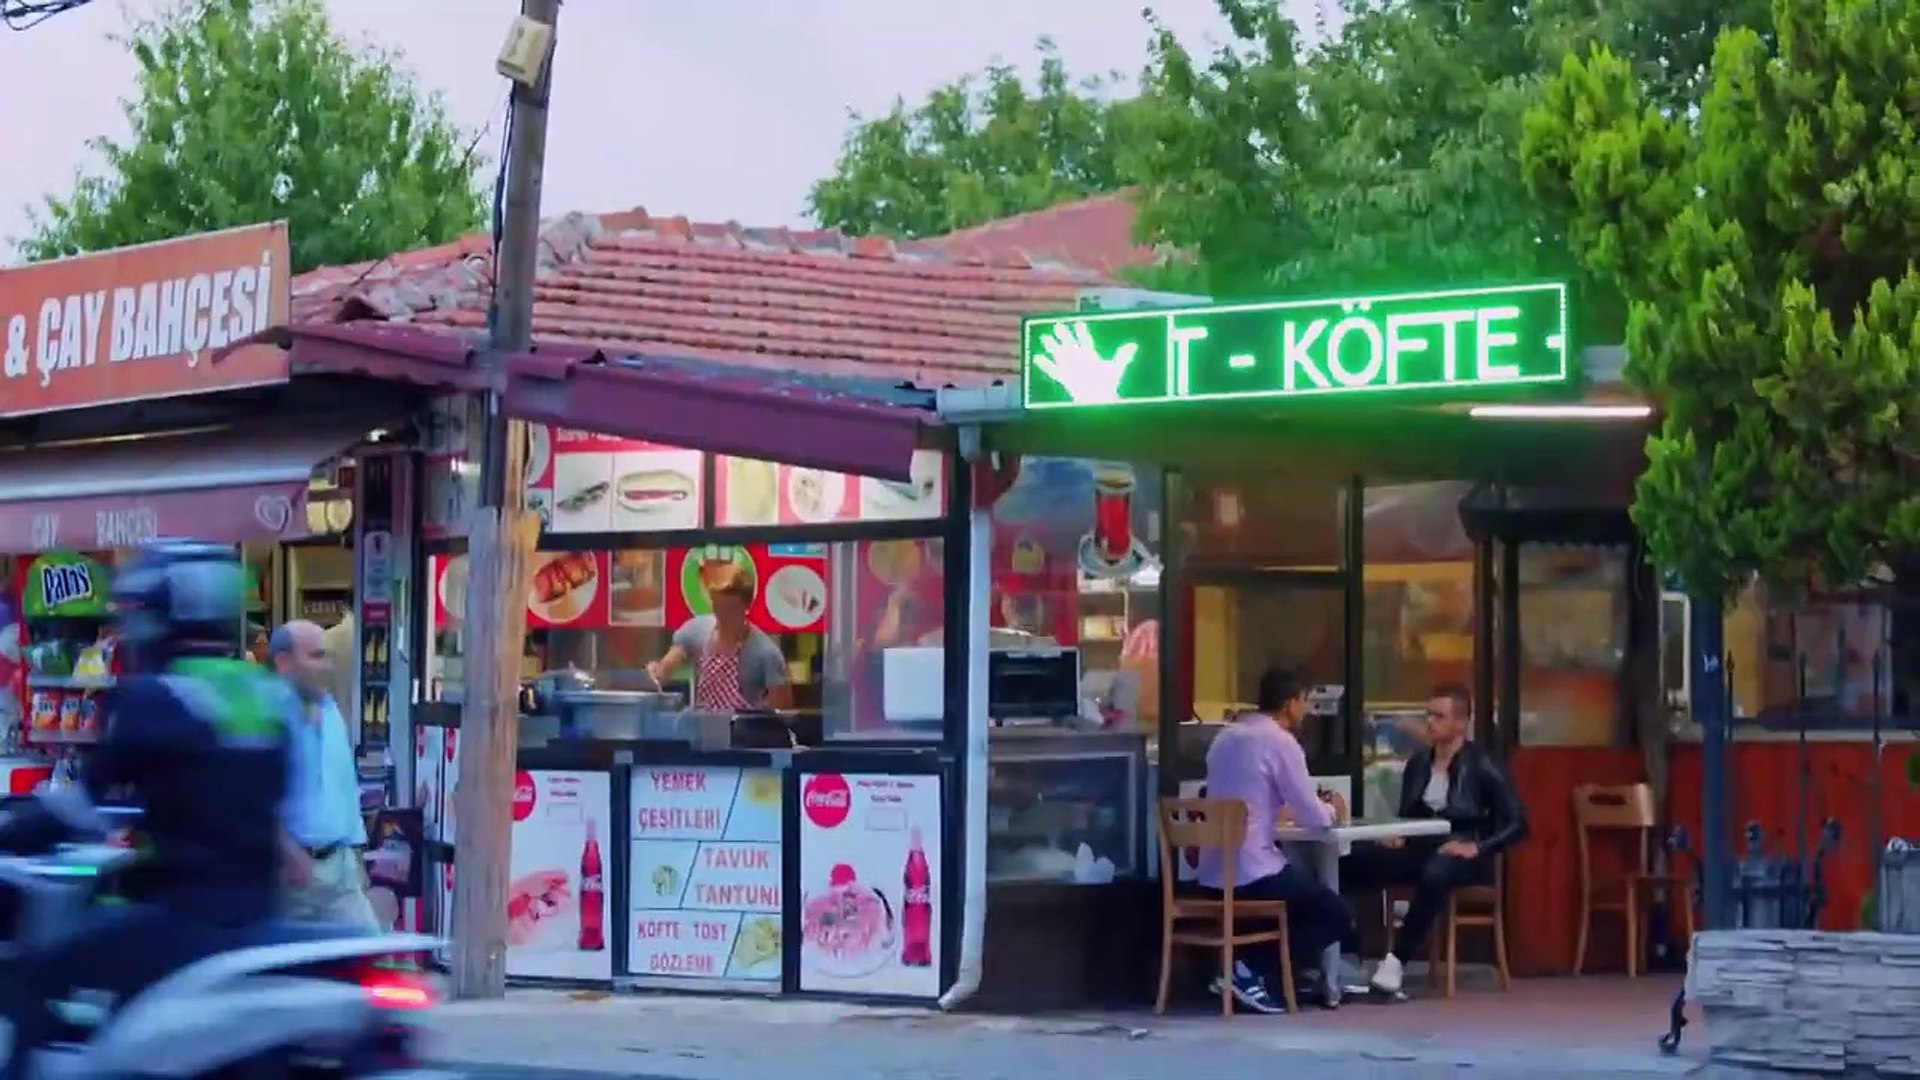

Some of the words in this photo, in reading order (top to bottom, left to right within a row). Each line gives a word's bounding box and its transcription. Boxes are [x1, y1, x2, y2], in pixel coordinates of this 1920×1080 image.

[5, 314, 29, 377] &
[37, 291, 106, 387] ÇAY
[110, 250, 271, 368] BAHÇESİ
[1284, 301, 1519, 391] KÖFTE
[651, 769, 706, 792] YEMEK
[704, 847, 769, 869] TAVUK
